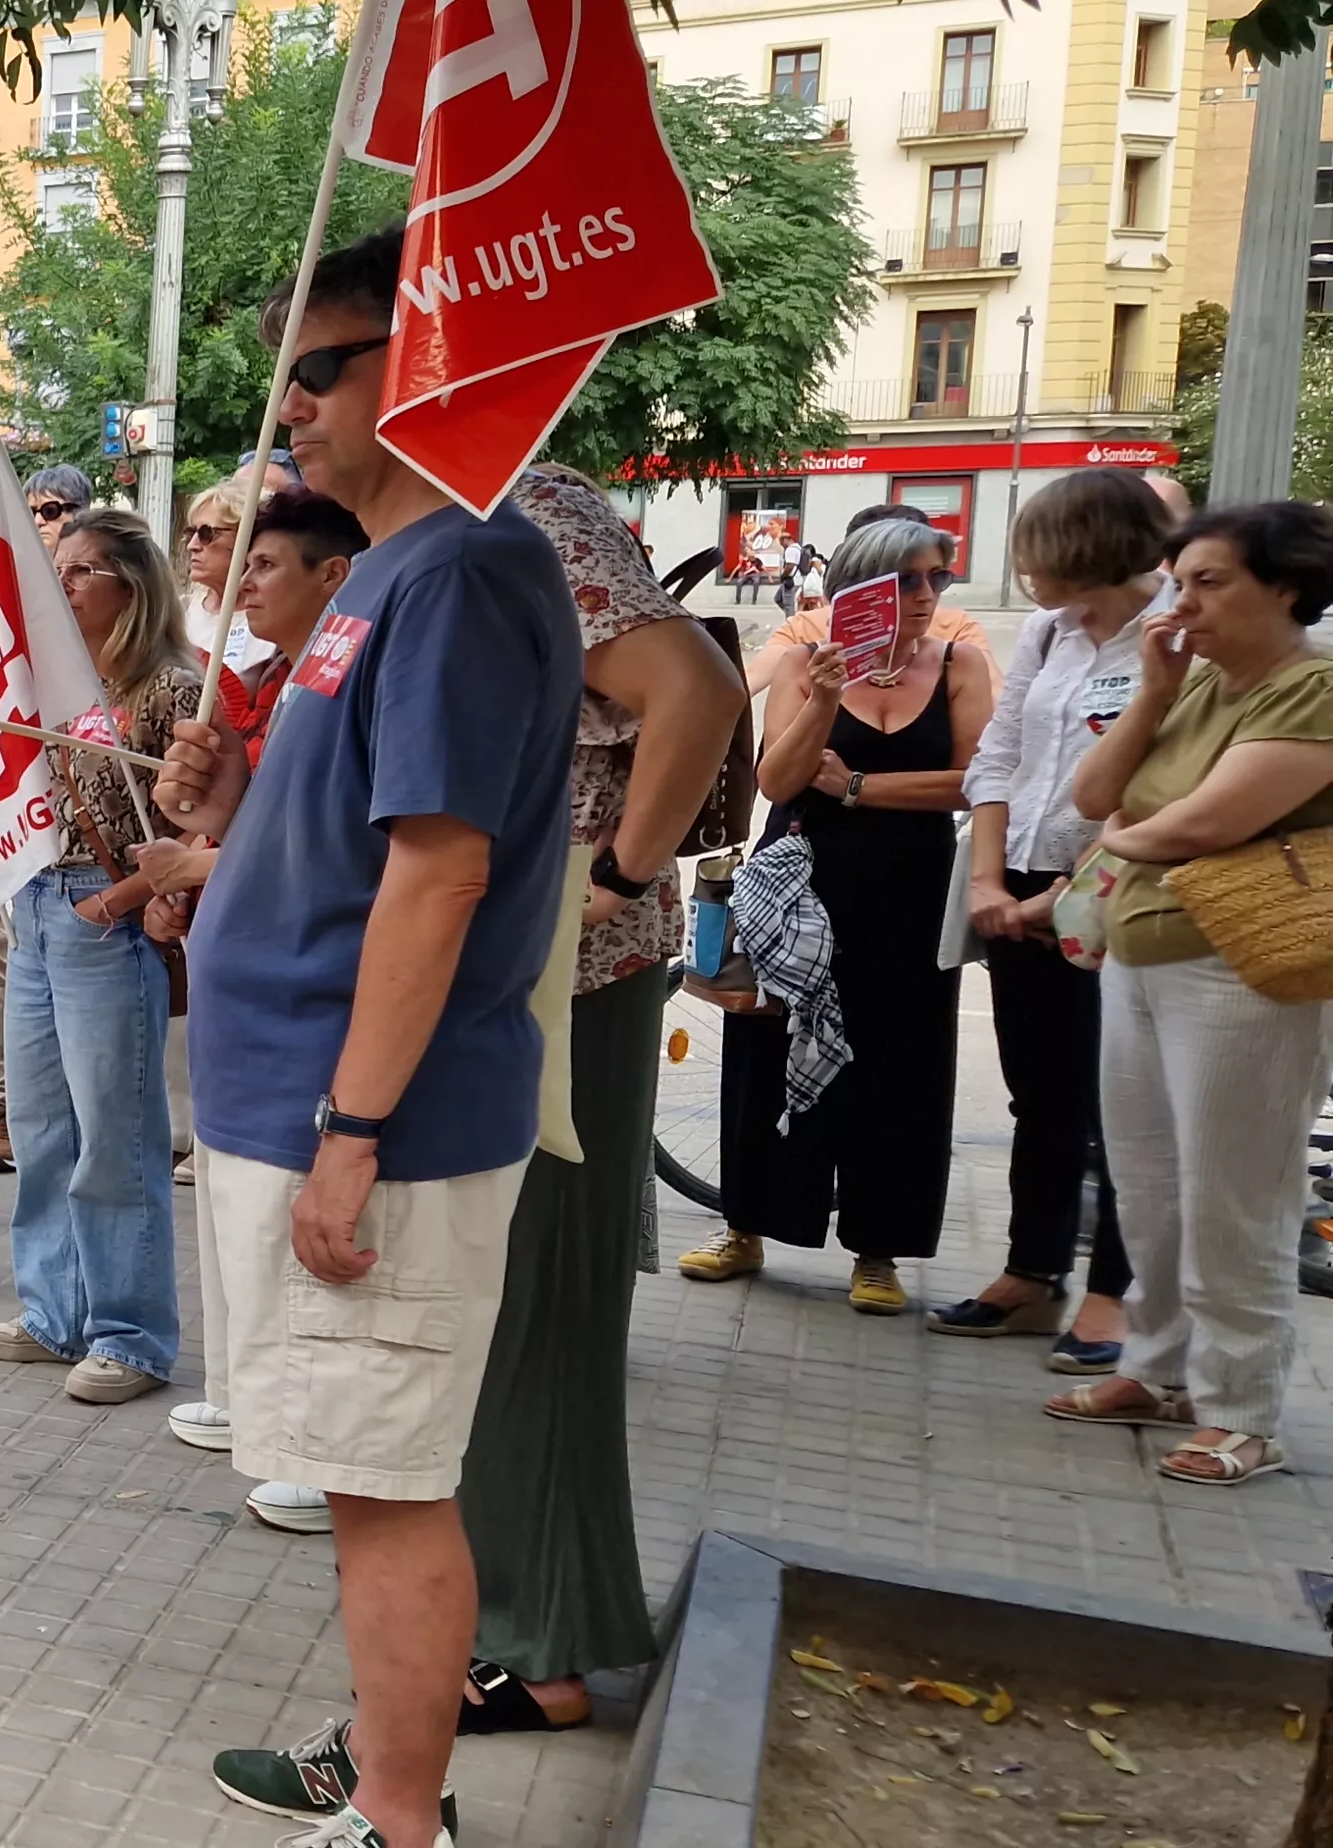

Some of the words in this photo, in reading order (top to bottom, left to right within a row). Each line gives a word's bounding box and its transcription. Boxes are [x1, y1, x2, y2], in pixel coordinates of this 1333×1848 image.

[399, 206, 636, 315] w.ugt.es
[780, 454, 867, 470] Sntander
[1101, 447, 1158, 462] Santander
[1092, 676, 1132, 690] STOP
[298, 1763, 349, 1805] N
